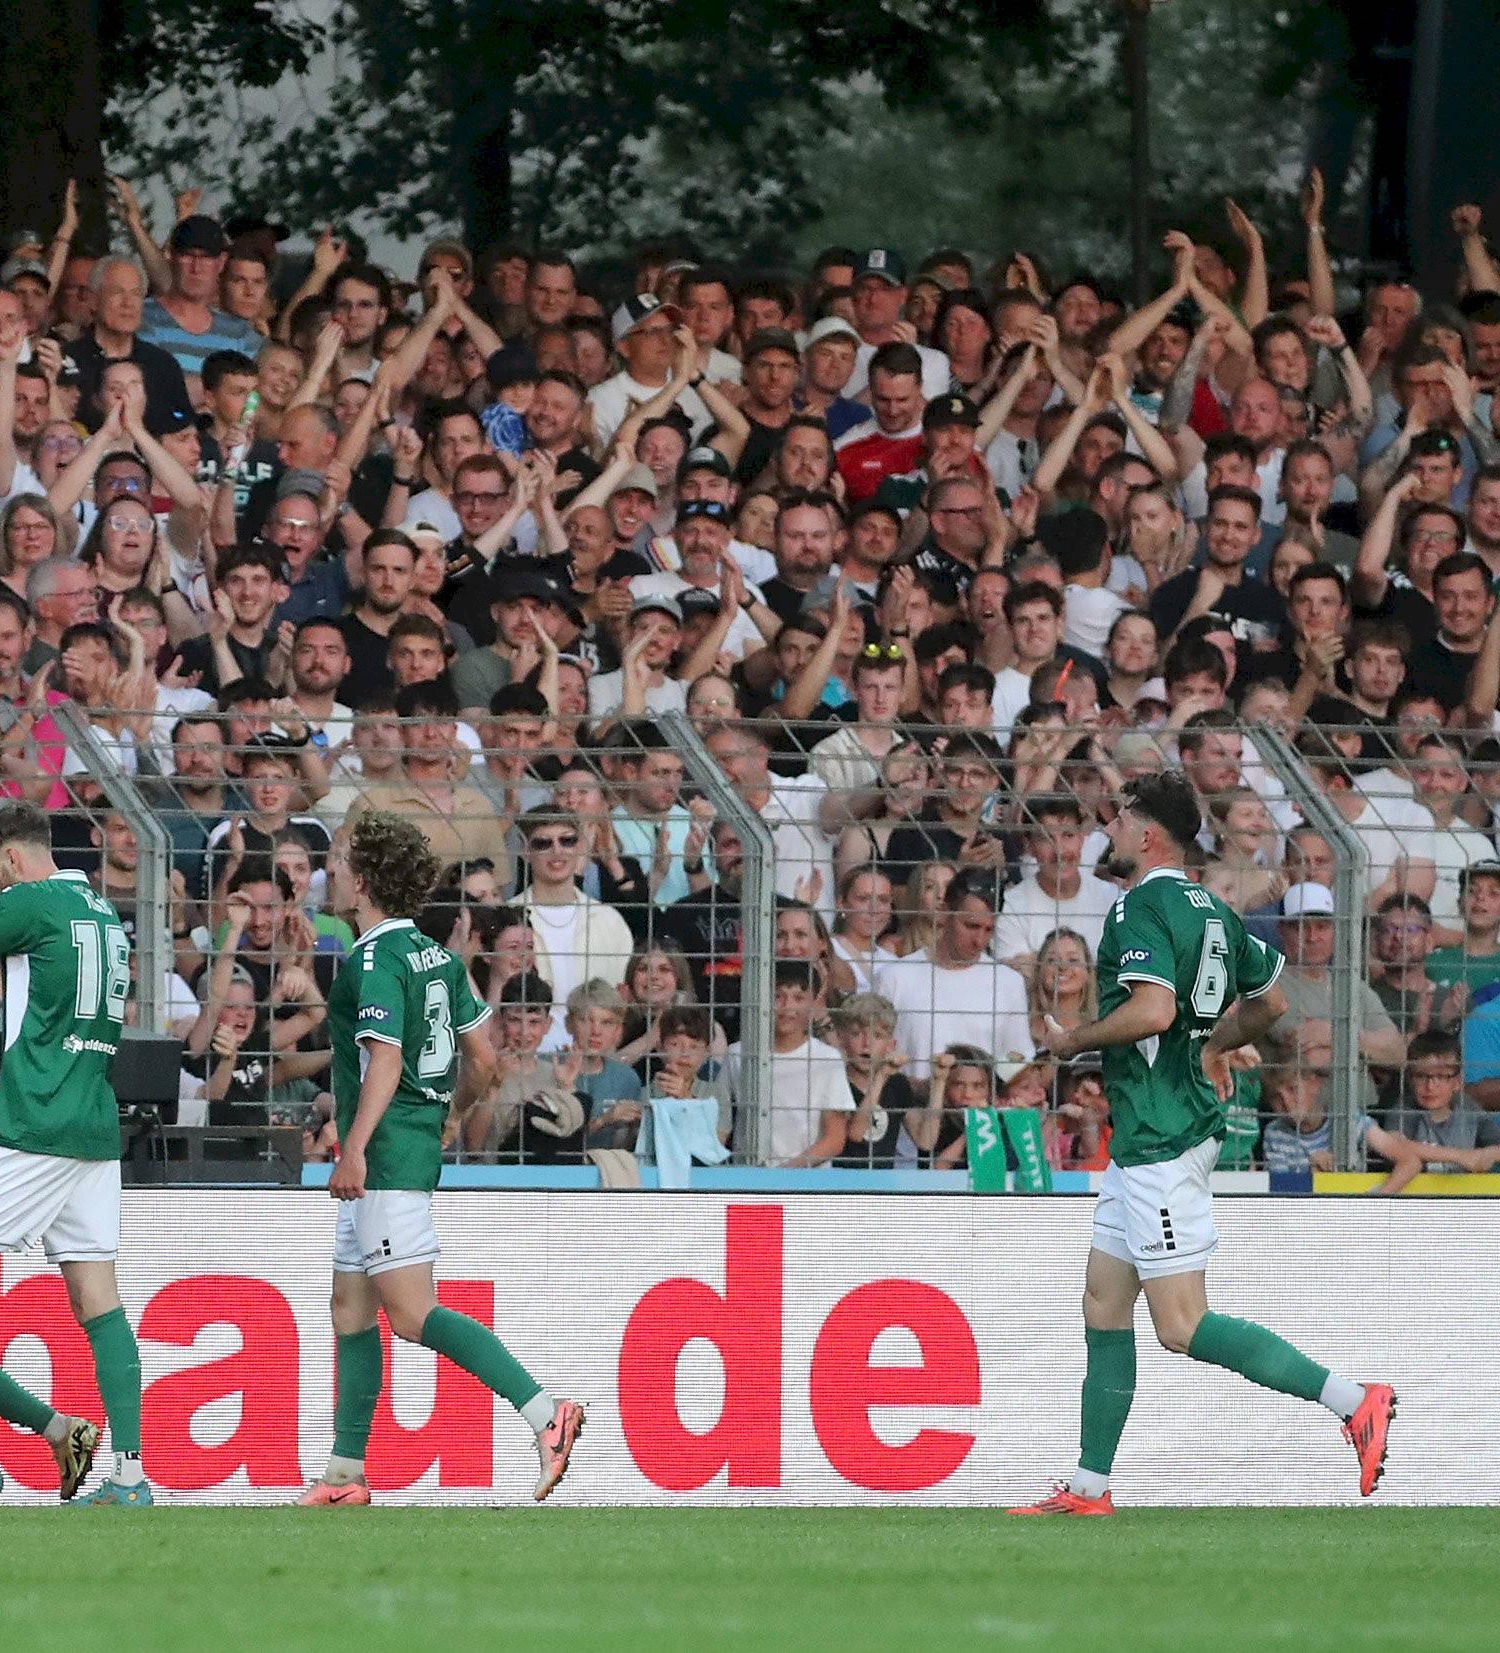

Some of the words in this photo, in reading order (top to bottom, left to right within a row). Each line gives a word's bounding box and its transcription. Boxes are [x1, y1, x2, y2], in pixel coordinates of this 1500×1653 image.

[70, 920, 131, 1023] 18
[358, 1005, 386, 1020] HYLO
[1190, 918, 1229, 1018] 6
[418, 978, 456, 1079] 3
